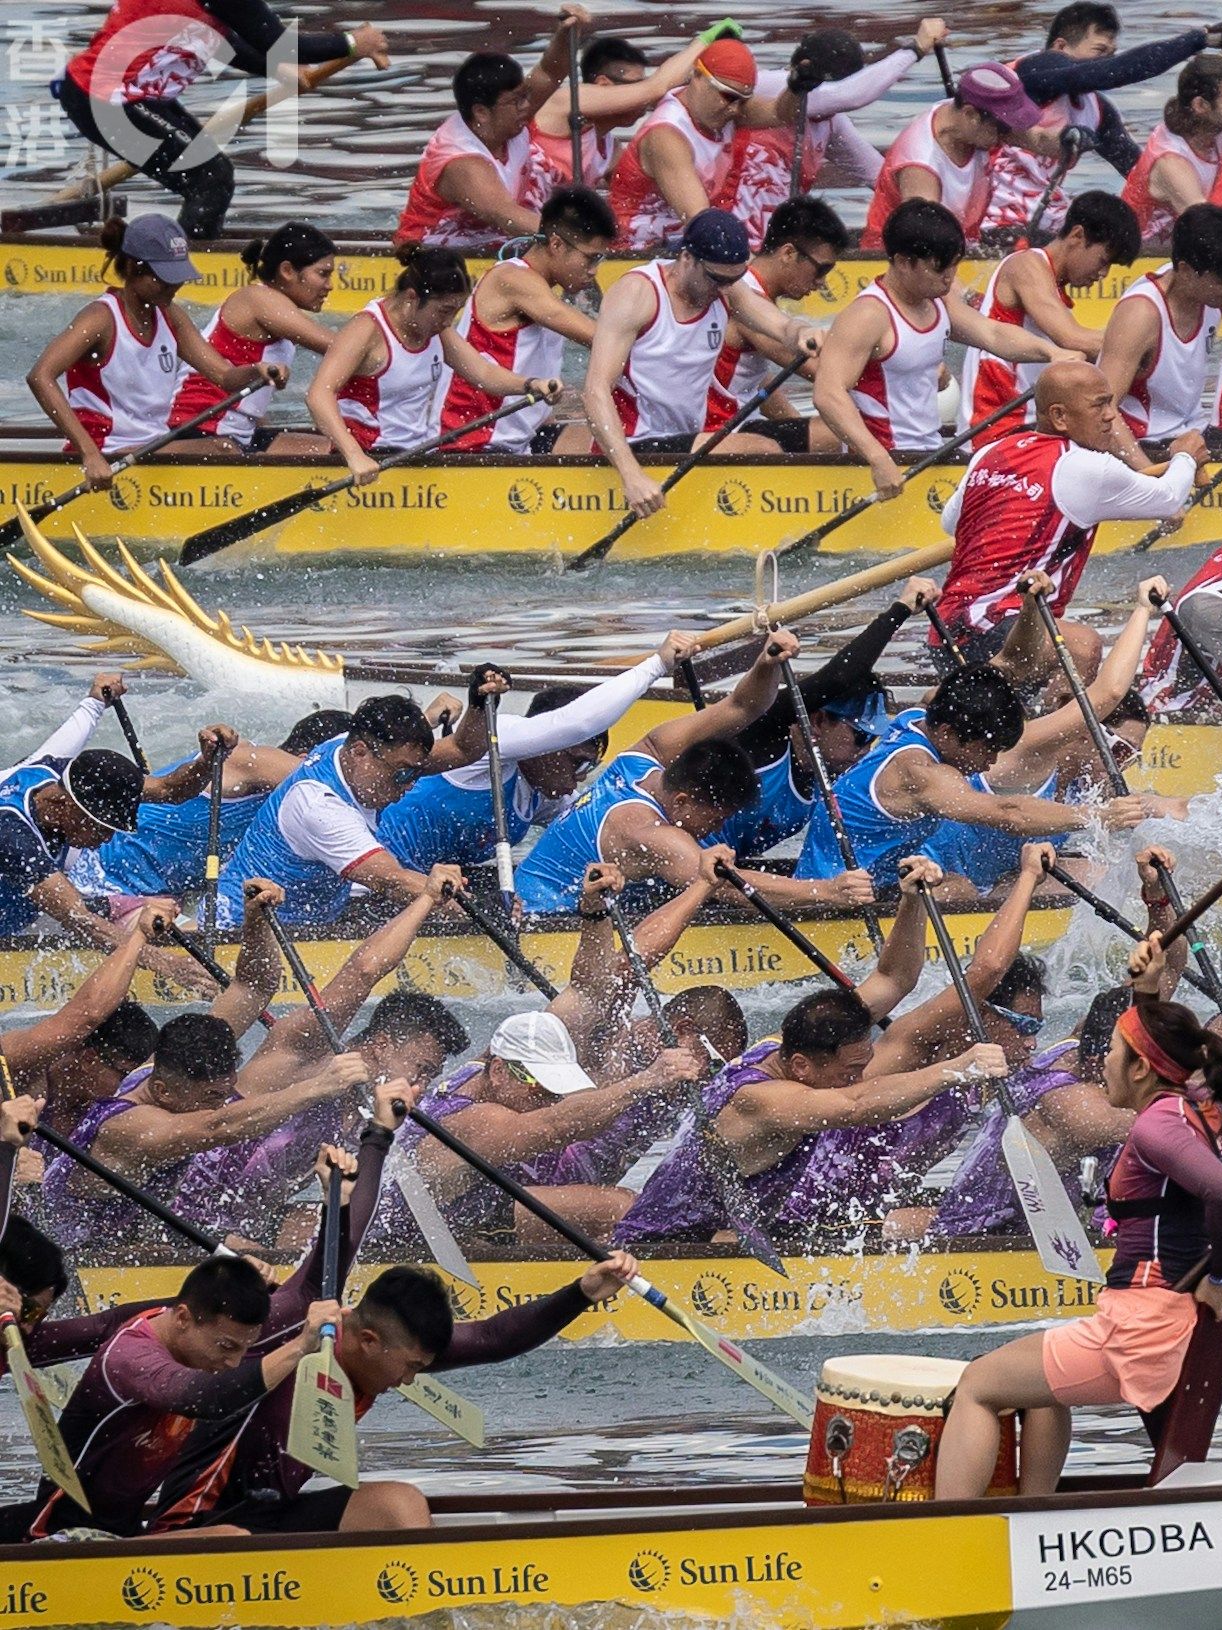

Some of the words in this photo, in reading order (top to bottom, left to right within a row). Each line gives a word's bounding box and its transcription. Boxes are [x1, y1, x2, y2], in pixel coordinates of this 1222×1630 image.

[34, 265, 67, 283] Sun
[71, 264, 102, 283] Life
[338, 269, 376, 291] Sun
[149, 485, 193, 508] Sun
[200, 483, 243, 508] Life
[347, 485, 395, 508] Sun
[401, 483, 448, 509] Life
[552, 487, 602, 511] Sun
[760, 489, 810, 513] Sun
[670, 952, 723, 977] Sun
[730, 945, 782, 973] Life
[743, 1283, 800, 1311] Sun
[991, 1279, 1050, 1308] Sun
[1038, 1521, 1214, 1563] HKCDBA
[428, 1570, 487, 1597] Sun
[493, 1564, 549, 1594] Life
[680, 1558, 739, 1585] Sun
[745, 1552, 803, 1582] Life
[175, 1576, 235, 1605] Sun
[242, 1571, 301, 1602] Life
